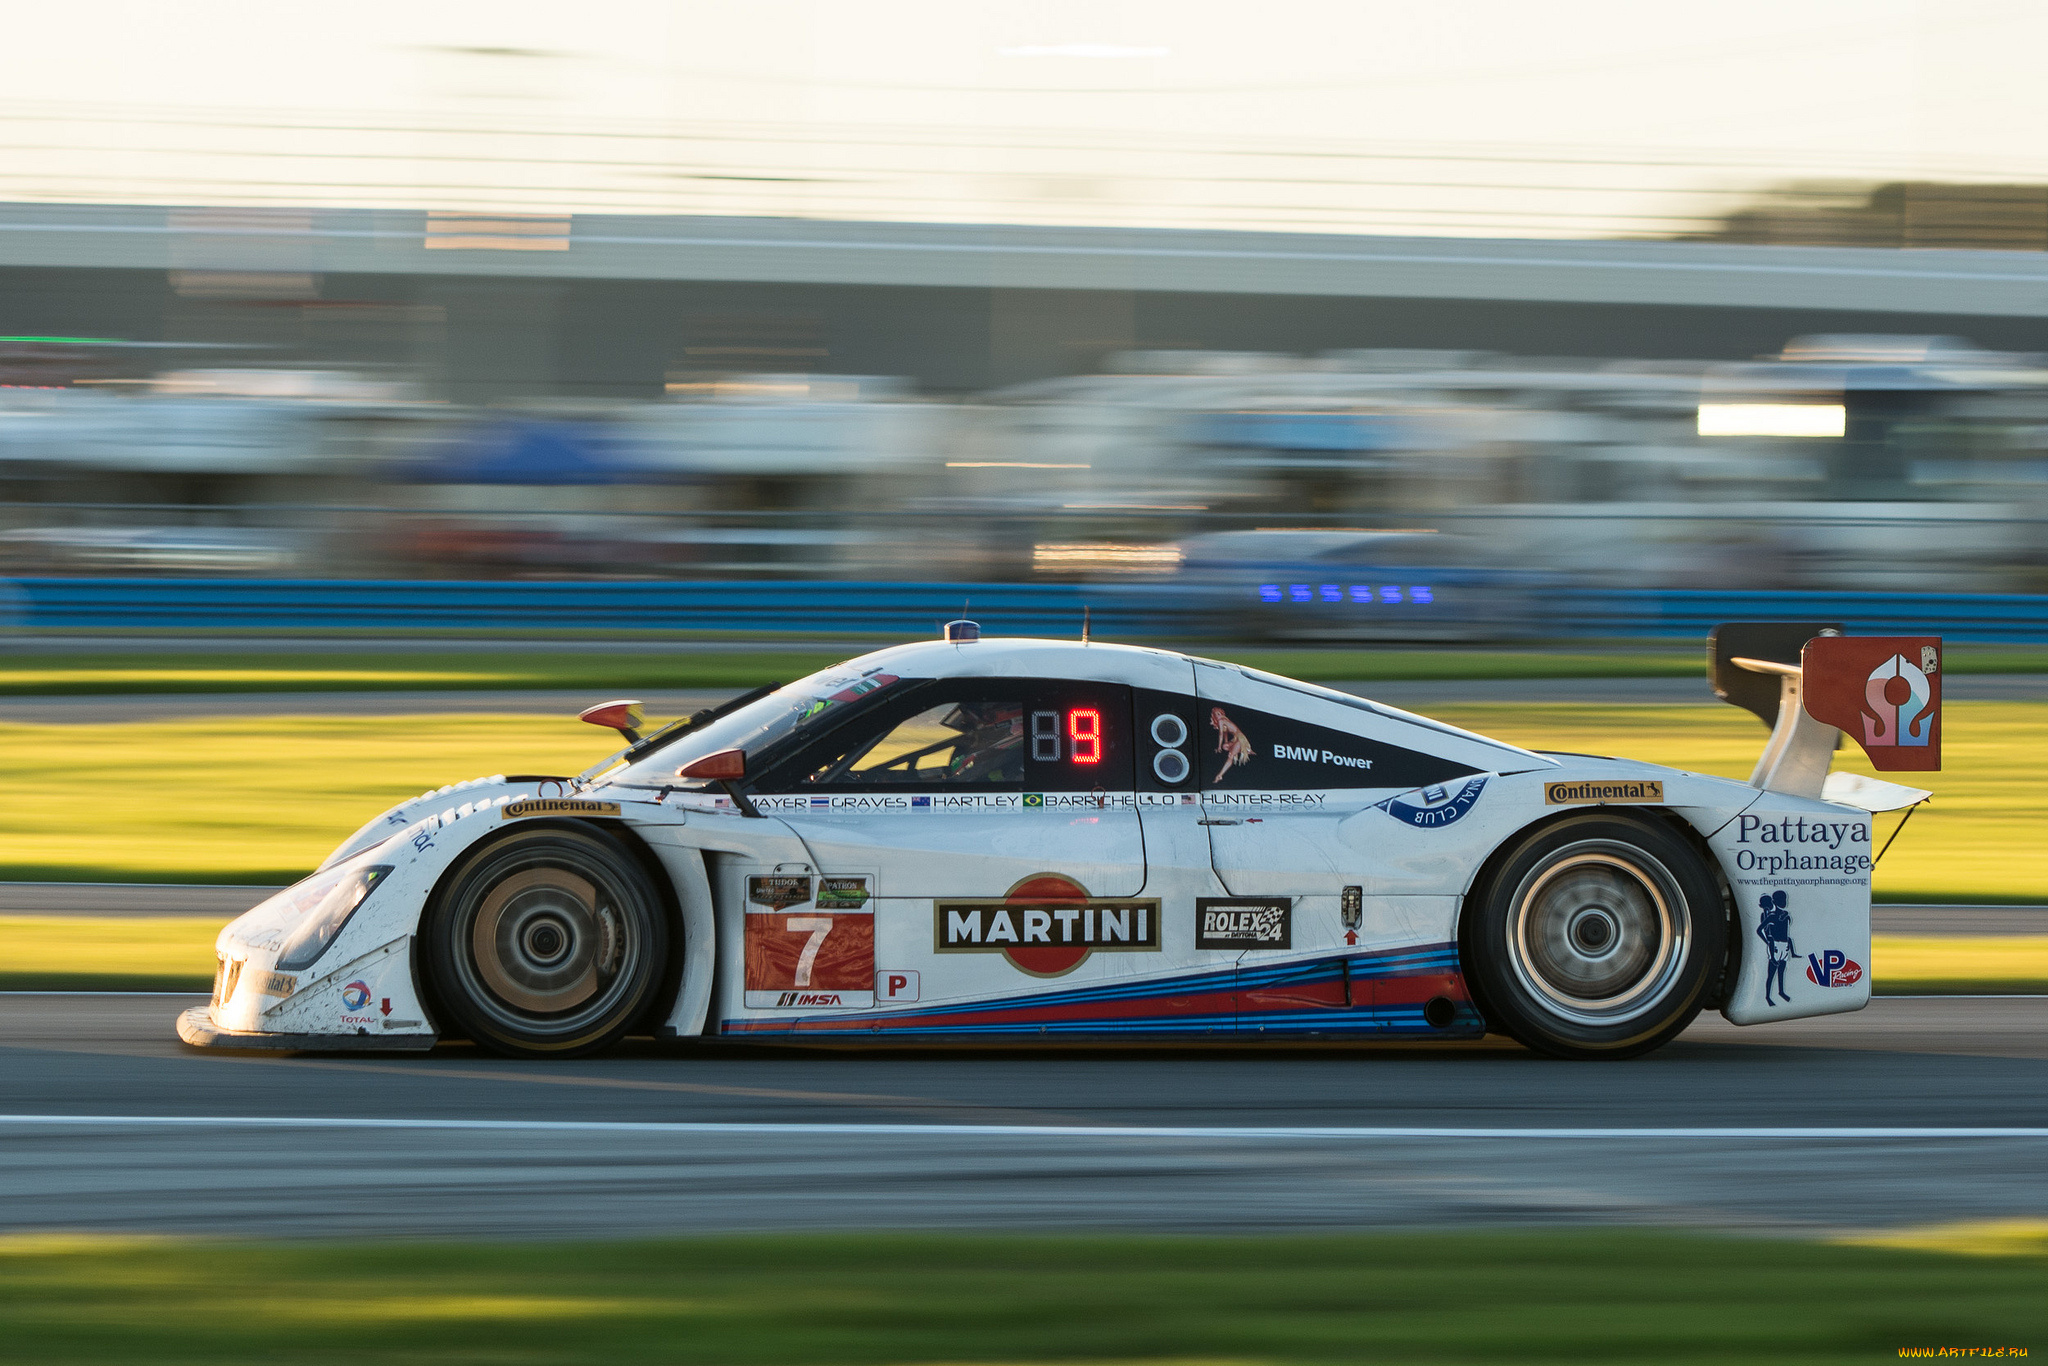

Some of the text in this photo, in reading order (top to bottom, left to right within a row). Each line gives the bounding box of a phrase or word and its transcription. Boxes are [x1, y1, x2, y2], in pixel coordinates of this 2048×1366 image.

[1273, 744, 1374, 770] BMW Power
[831, 797, 907, 808] GRAVES
[932, 795, 1019, 807] HARTLEY
[1201, 793, 1326, 806] HUNTER-REAY
[1548, 783, 1646, 804] Continental
[505, 800, 604, 817] Continental
[1414, 806, 1457, 824] CLUB
[1737, 814, 1870, 850] Pattaya
[1737, 849, 1871, 876] Orphanage
[947, 909, 1148, 943] MARTINI
[1203, 912, 1282, 942] ROLEX 24
[786, 917, 834, 987] 7
[1808, 950, 1846, 988] VP
[888, 975, 907, 997] P
[797, 994, 843, 1006] IMSA
[340, 1015, 375, 1024] TOTAL
